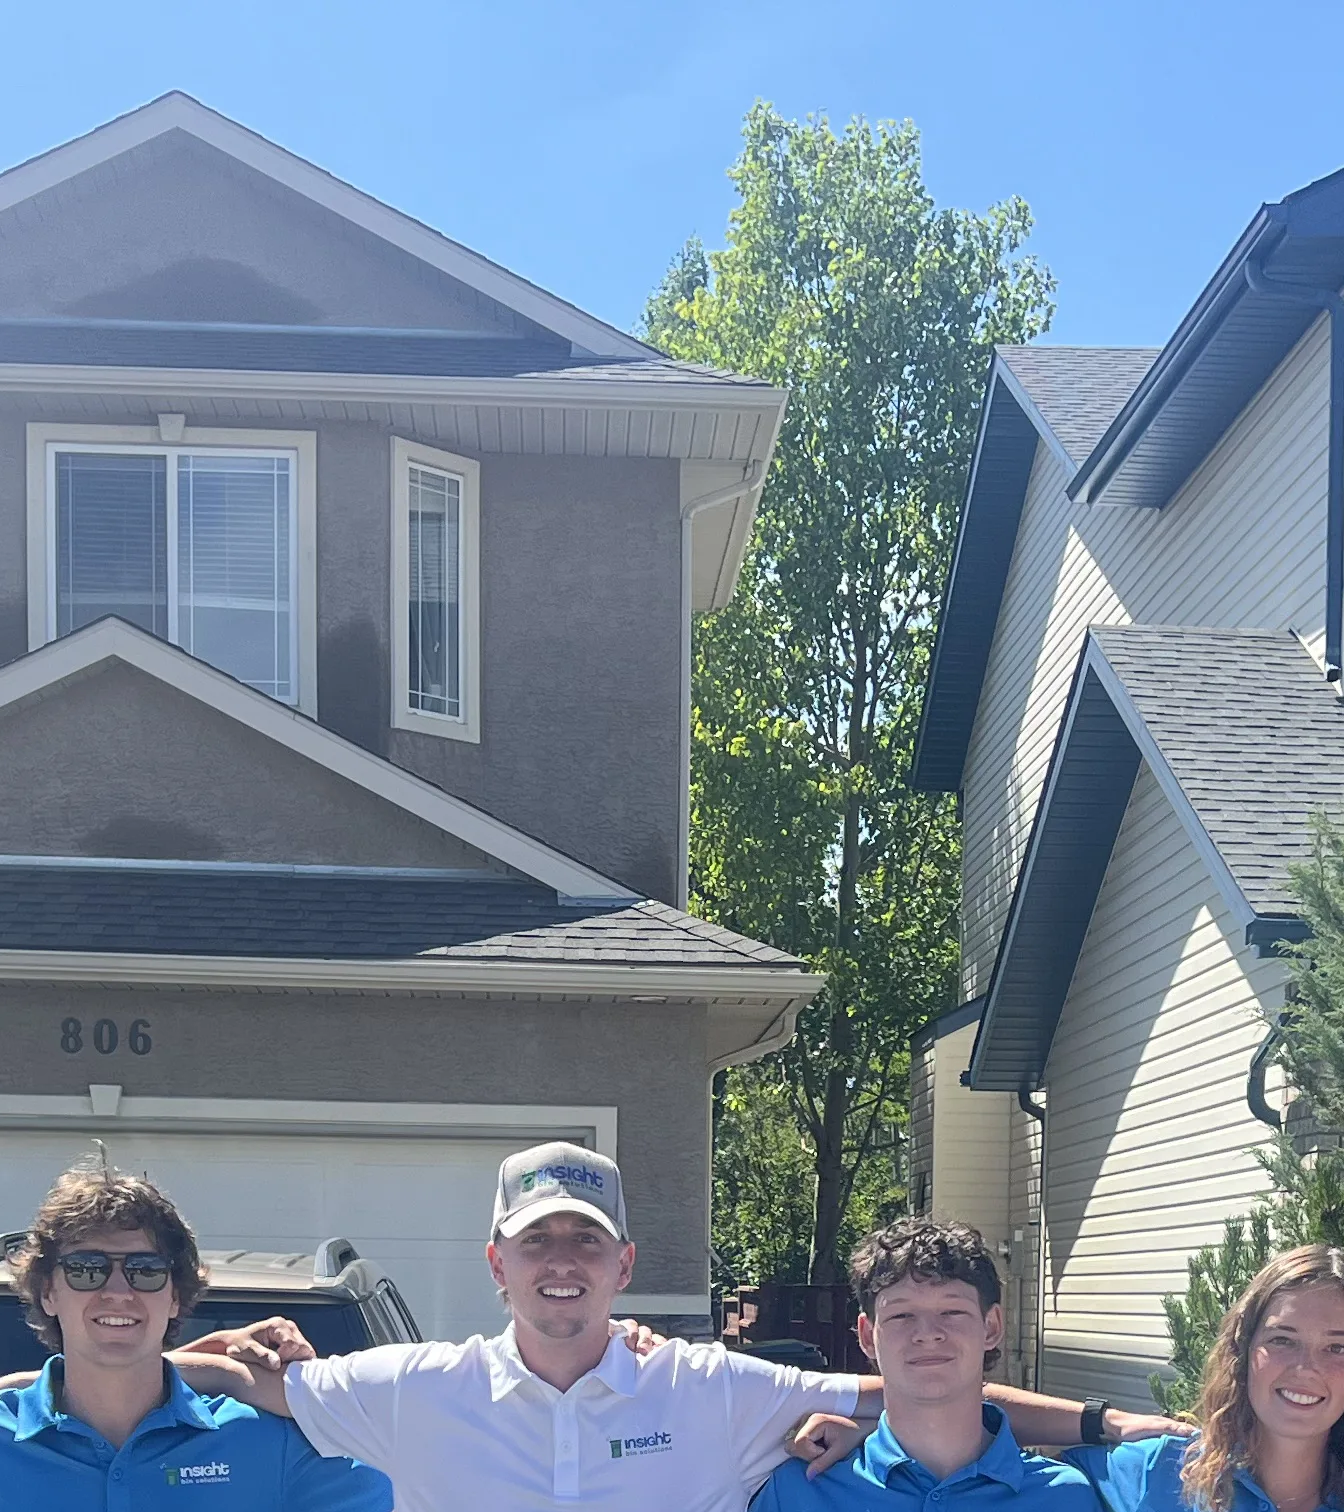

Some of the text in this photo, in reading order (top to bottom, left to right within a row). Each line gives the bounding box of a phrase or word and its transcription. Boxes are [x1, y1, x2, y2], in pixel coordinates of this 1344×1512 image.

[60, 1016, 152, 1056] 806
[624, 1431, 672, 1449] insight
[179, 1461, 230, 1478] insight
